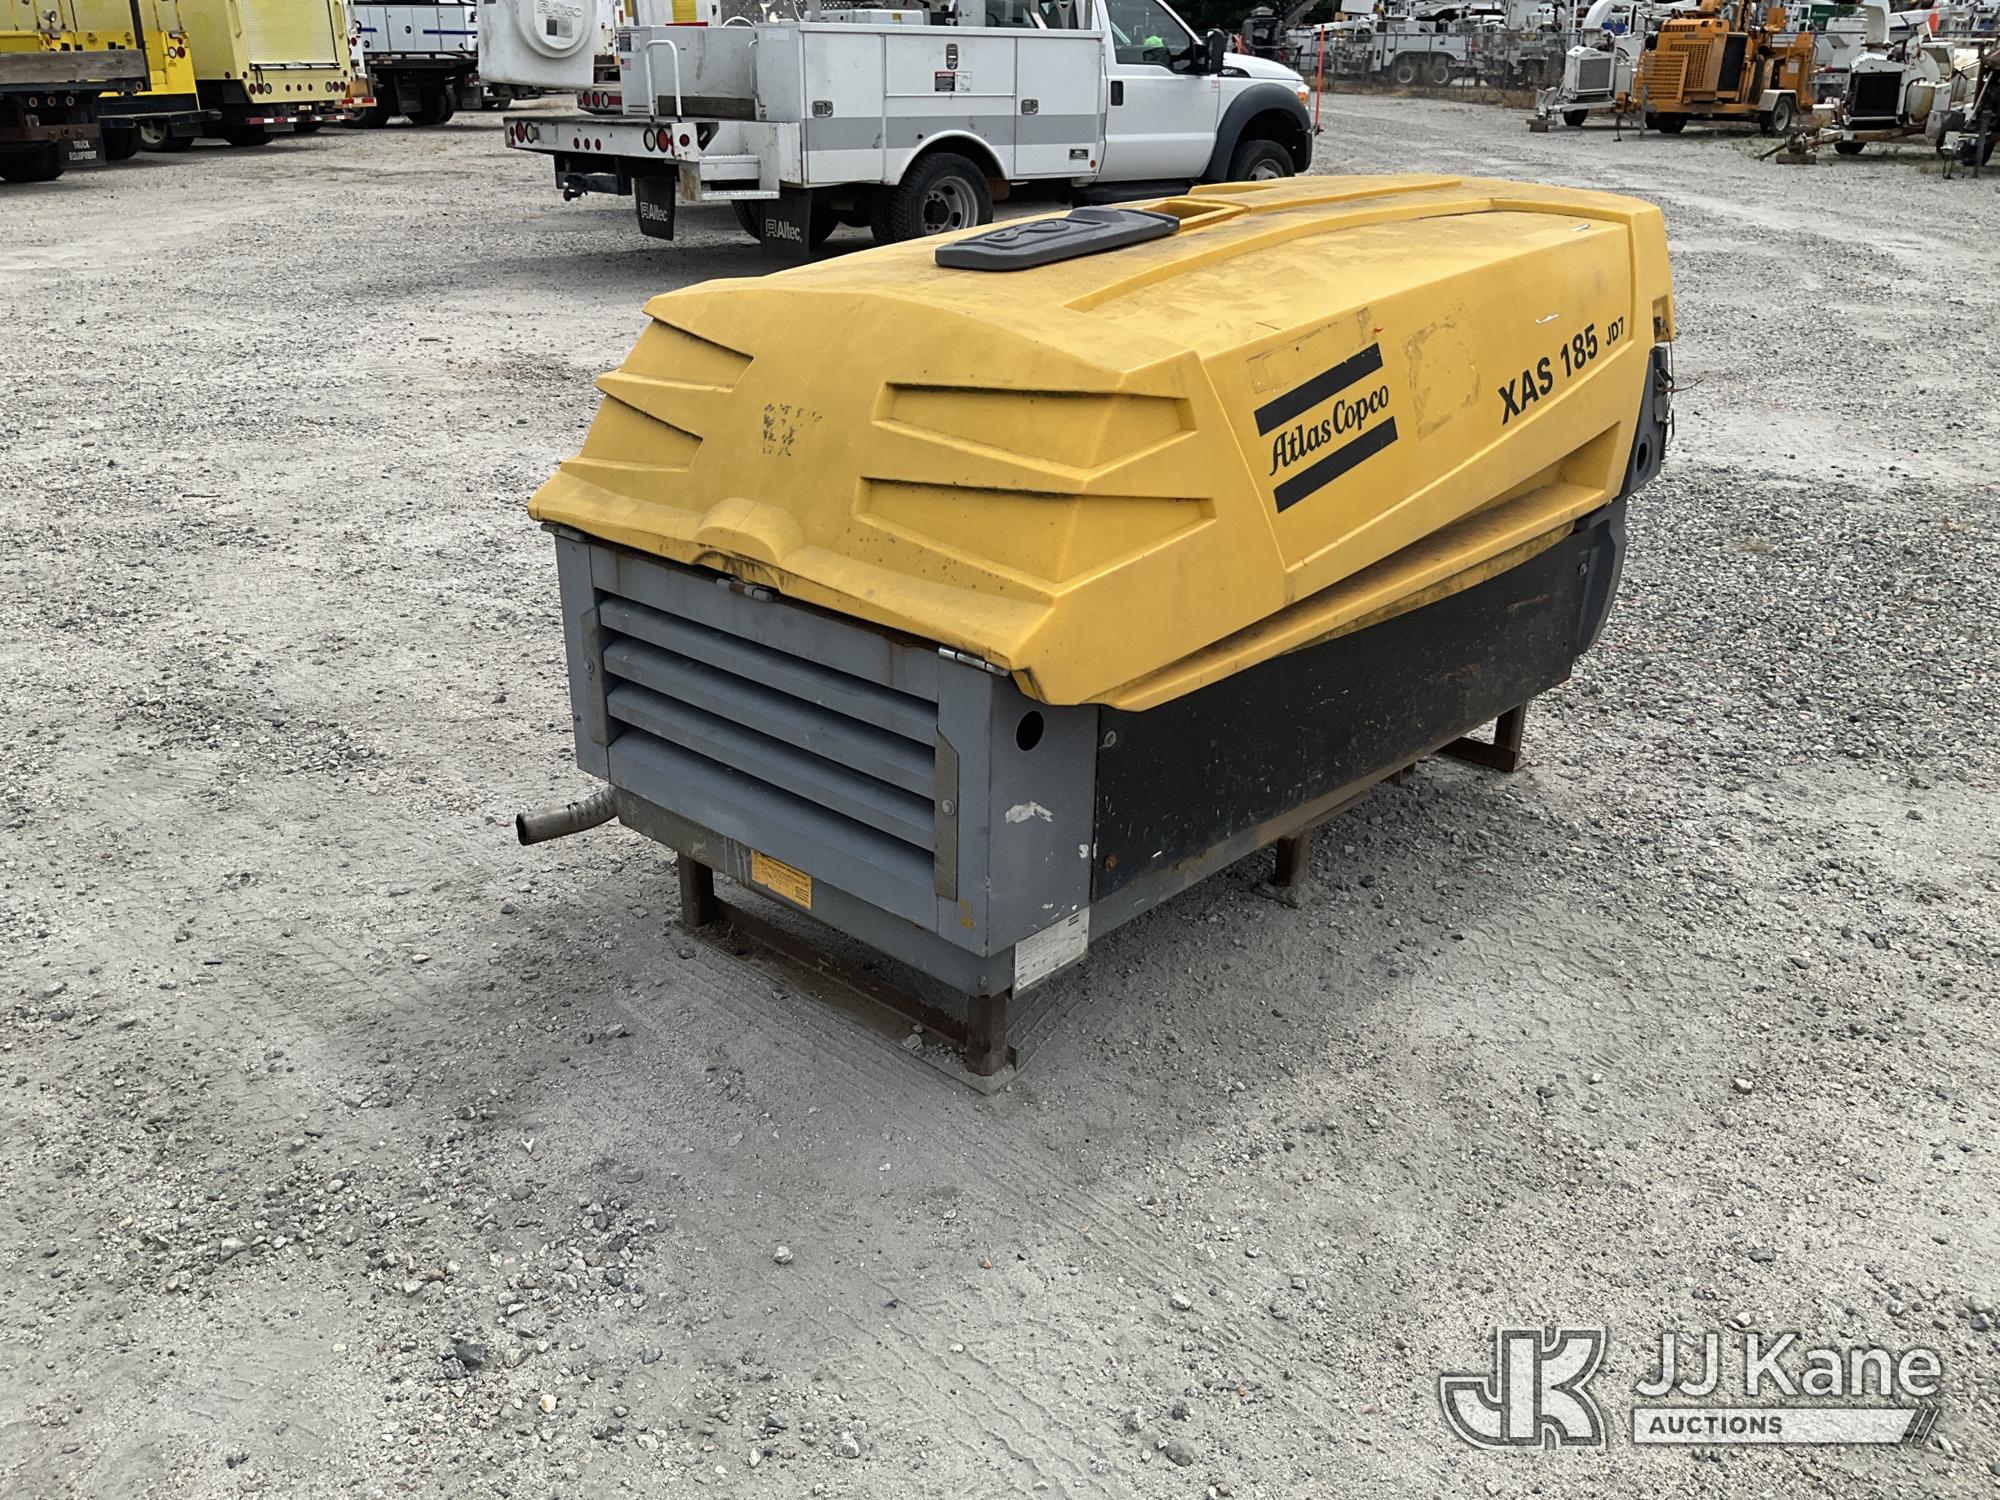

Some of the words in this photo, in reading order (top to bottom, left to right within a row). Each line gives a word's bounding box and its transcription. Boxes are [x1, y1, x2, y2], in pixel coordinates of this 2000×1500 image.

[649, 203, 668, 222] Altec
[777, 220, 801, 240] Altec
[1497, 356, 1554, 426] XAS
[1560, 323, 1598, 378] 185
[1606, 316, 1624, 346] JD7
